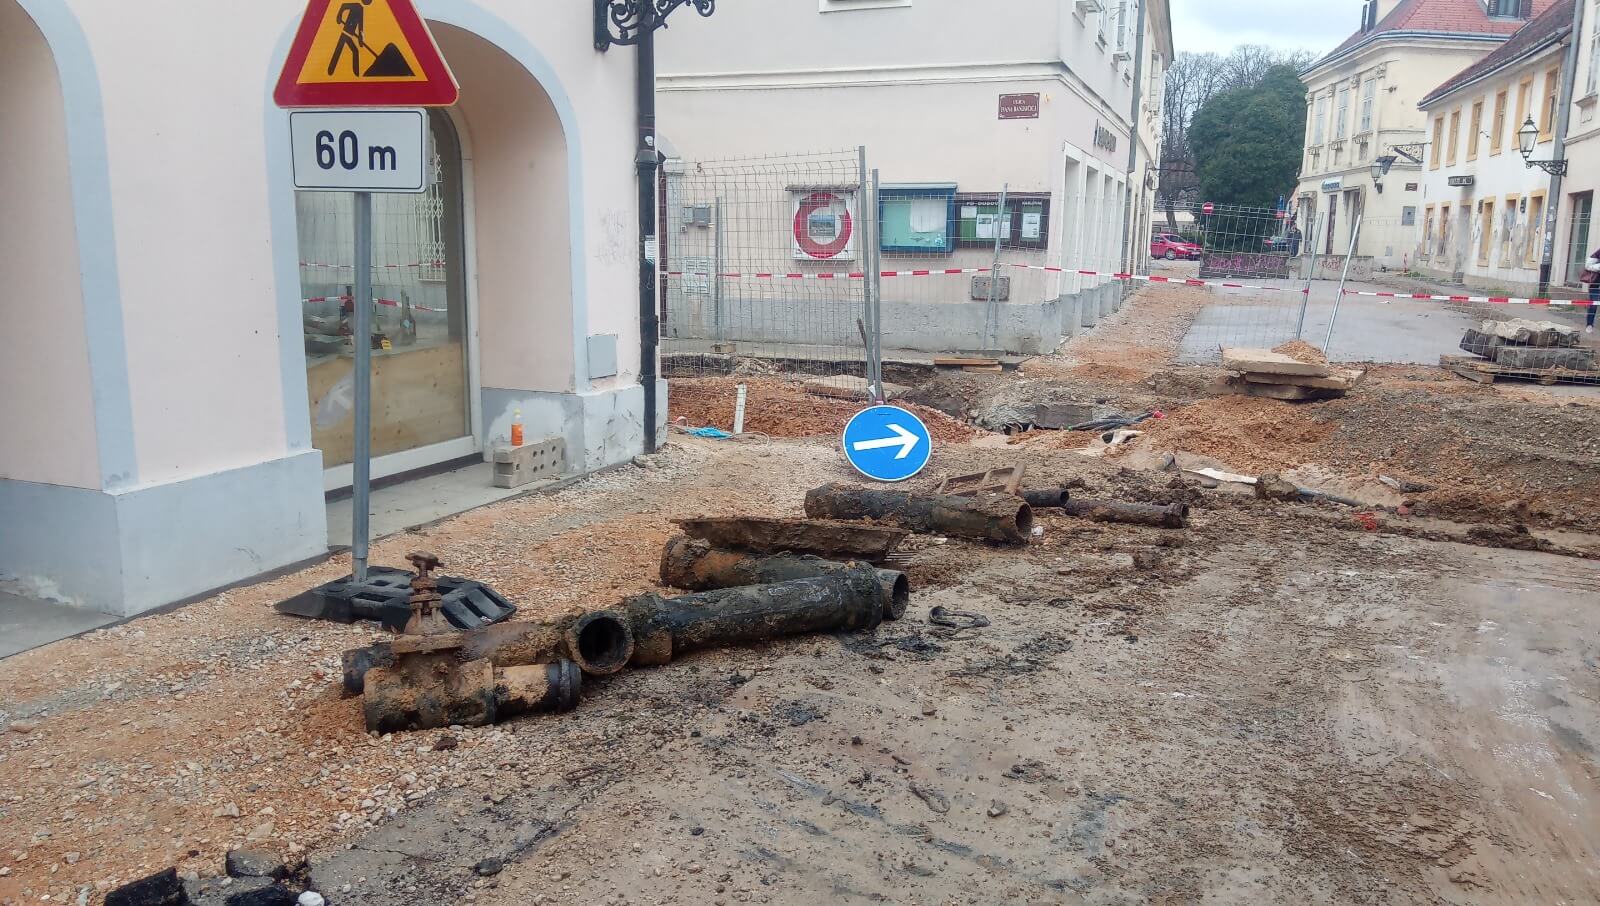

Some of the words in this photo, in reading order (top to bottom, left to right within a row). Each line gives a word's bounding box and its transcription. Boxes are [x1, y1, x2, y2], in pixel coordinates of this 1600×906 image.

[315, 130, 359, 170] 60
[368, 145, 397, 171] m
[696, 162, 702, 173] 5
